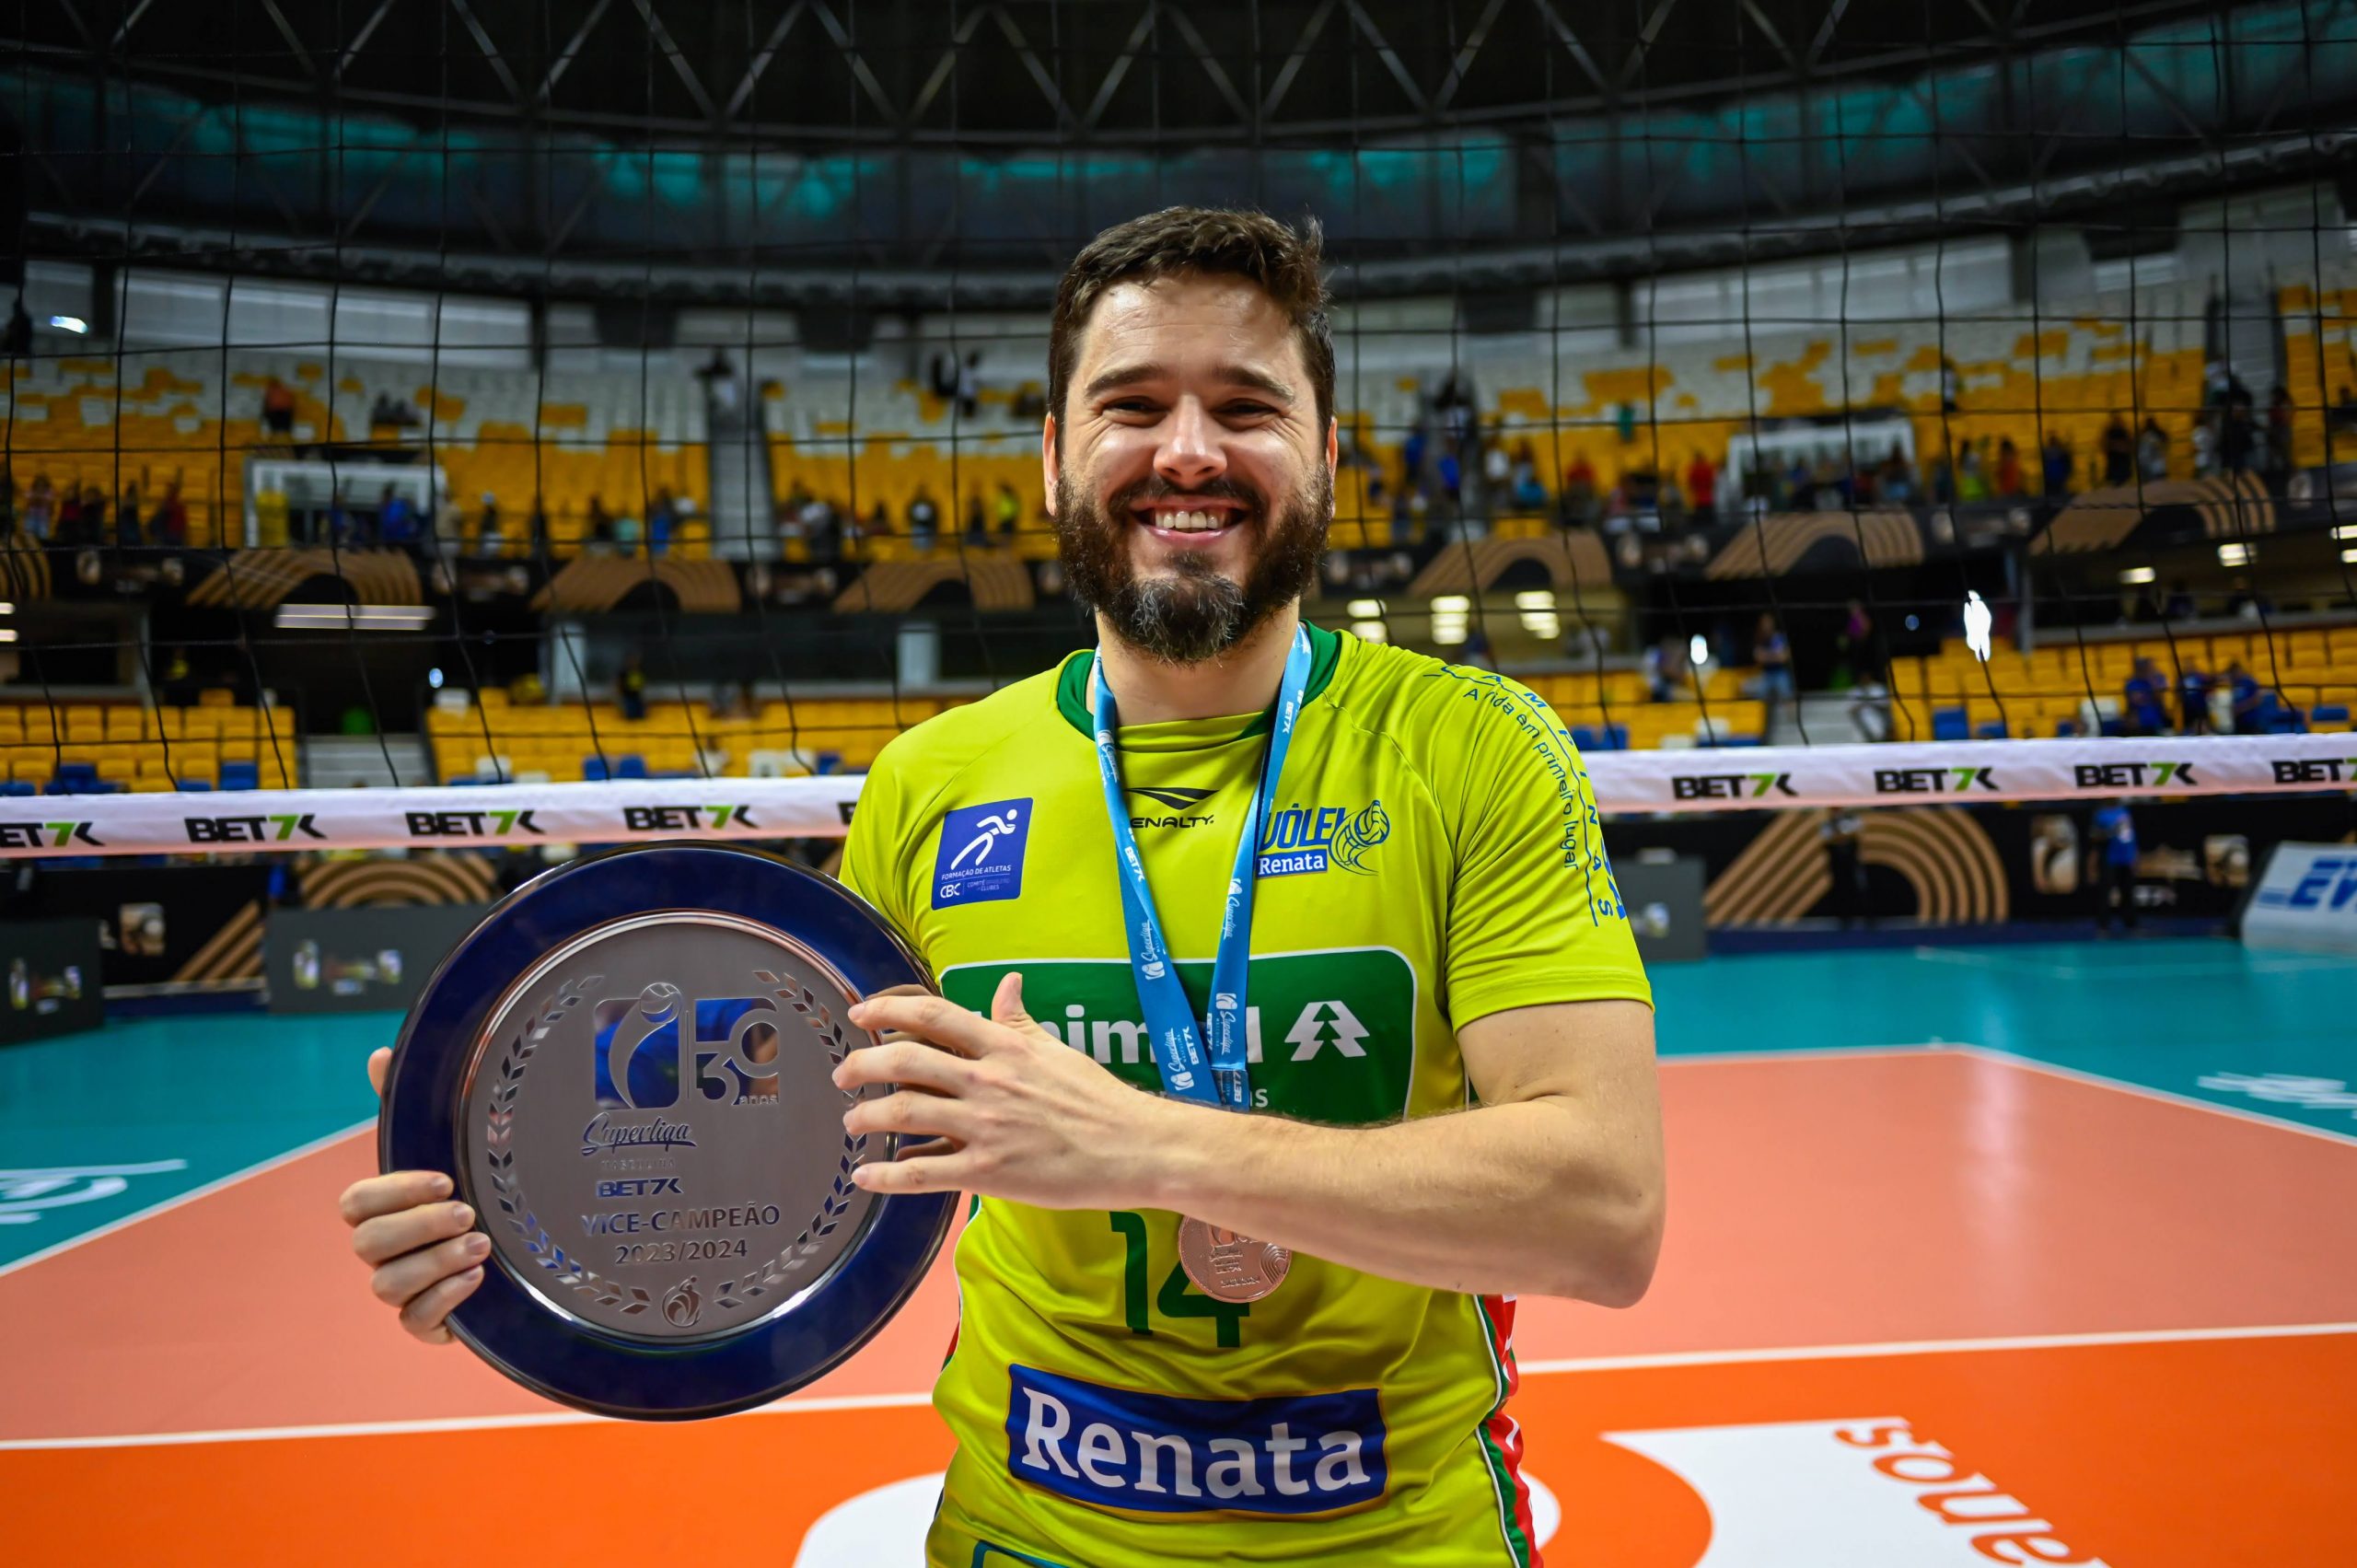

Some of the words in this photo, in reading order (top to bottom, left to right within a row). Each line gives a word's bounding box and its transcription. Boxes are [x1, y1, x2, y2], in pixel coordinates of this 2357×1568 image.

[1282, 700, 1295, 735] BET7K
[1462, 688, 1479, 701] A
[1516, 714, 1540, 739] em
[1532, 741, 1576, 816] primeiro
[1559, 819, 1579, 871] lugar
[1874, 767, 2000, 794] BET7K
[2073, 762, 2199, 788] BET7K
[2270, 758, 2357, 784] BET
[1480, 674, 1615, 918] AMPINAS
[1671, 772, 1799, 800] BET7K
[184, 814, 328, 843] BET7K
[405, 809, 546, 836] BET7K
[622, 804, 760, 831] BET7K
[1131, 814, 1214, 829] ENALTY
[0, 821, 106, 849] ET7K
[941, 868, 974, 881] FORMAÇÃO
[974, 866, 983, 876] DE
[983, 865, 1012, 874] ATLETAS
[1124, 845, 1144, 882] BET7K
[1258, 853, 1326, 876] Renata
[940, 882, 961, 899] CBC
[1182, 1026, 1200, 1065] BET7K
[1220, 1010, 1237, 1056] Superliga
[1165, 1028, 1186, 1073] Superliga
[738, 1094, 780, 1106] anos
[1233, 1071, 1242, 1103] BET7
[581, 1111, 698, 1156] Superliga
[597, 1176, 685, 1198] BET7K
[581, 1200, 782, 1237] VICE-CAMPEÃO
[614, 1238, 749, 1266] 2023/2024
[1109, 1210, 1251, 1348] 14
[1020, 1386, 1371, 1500] Renata
